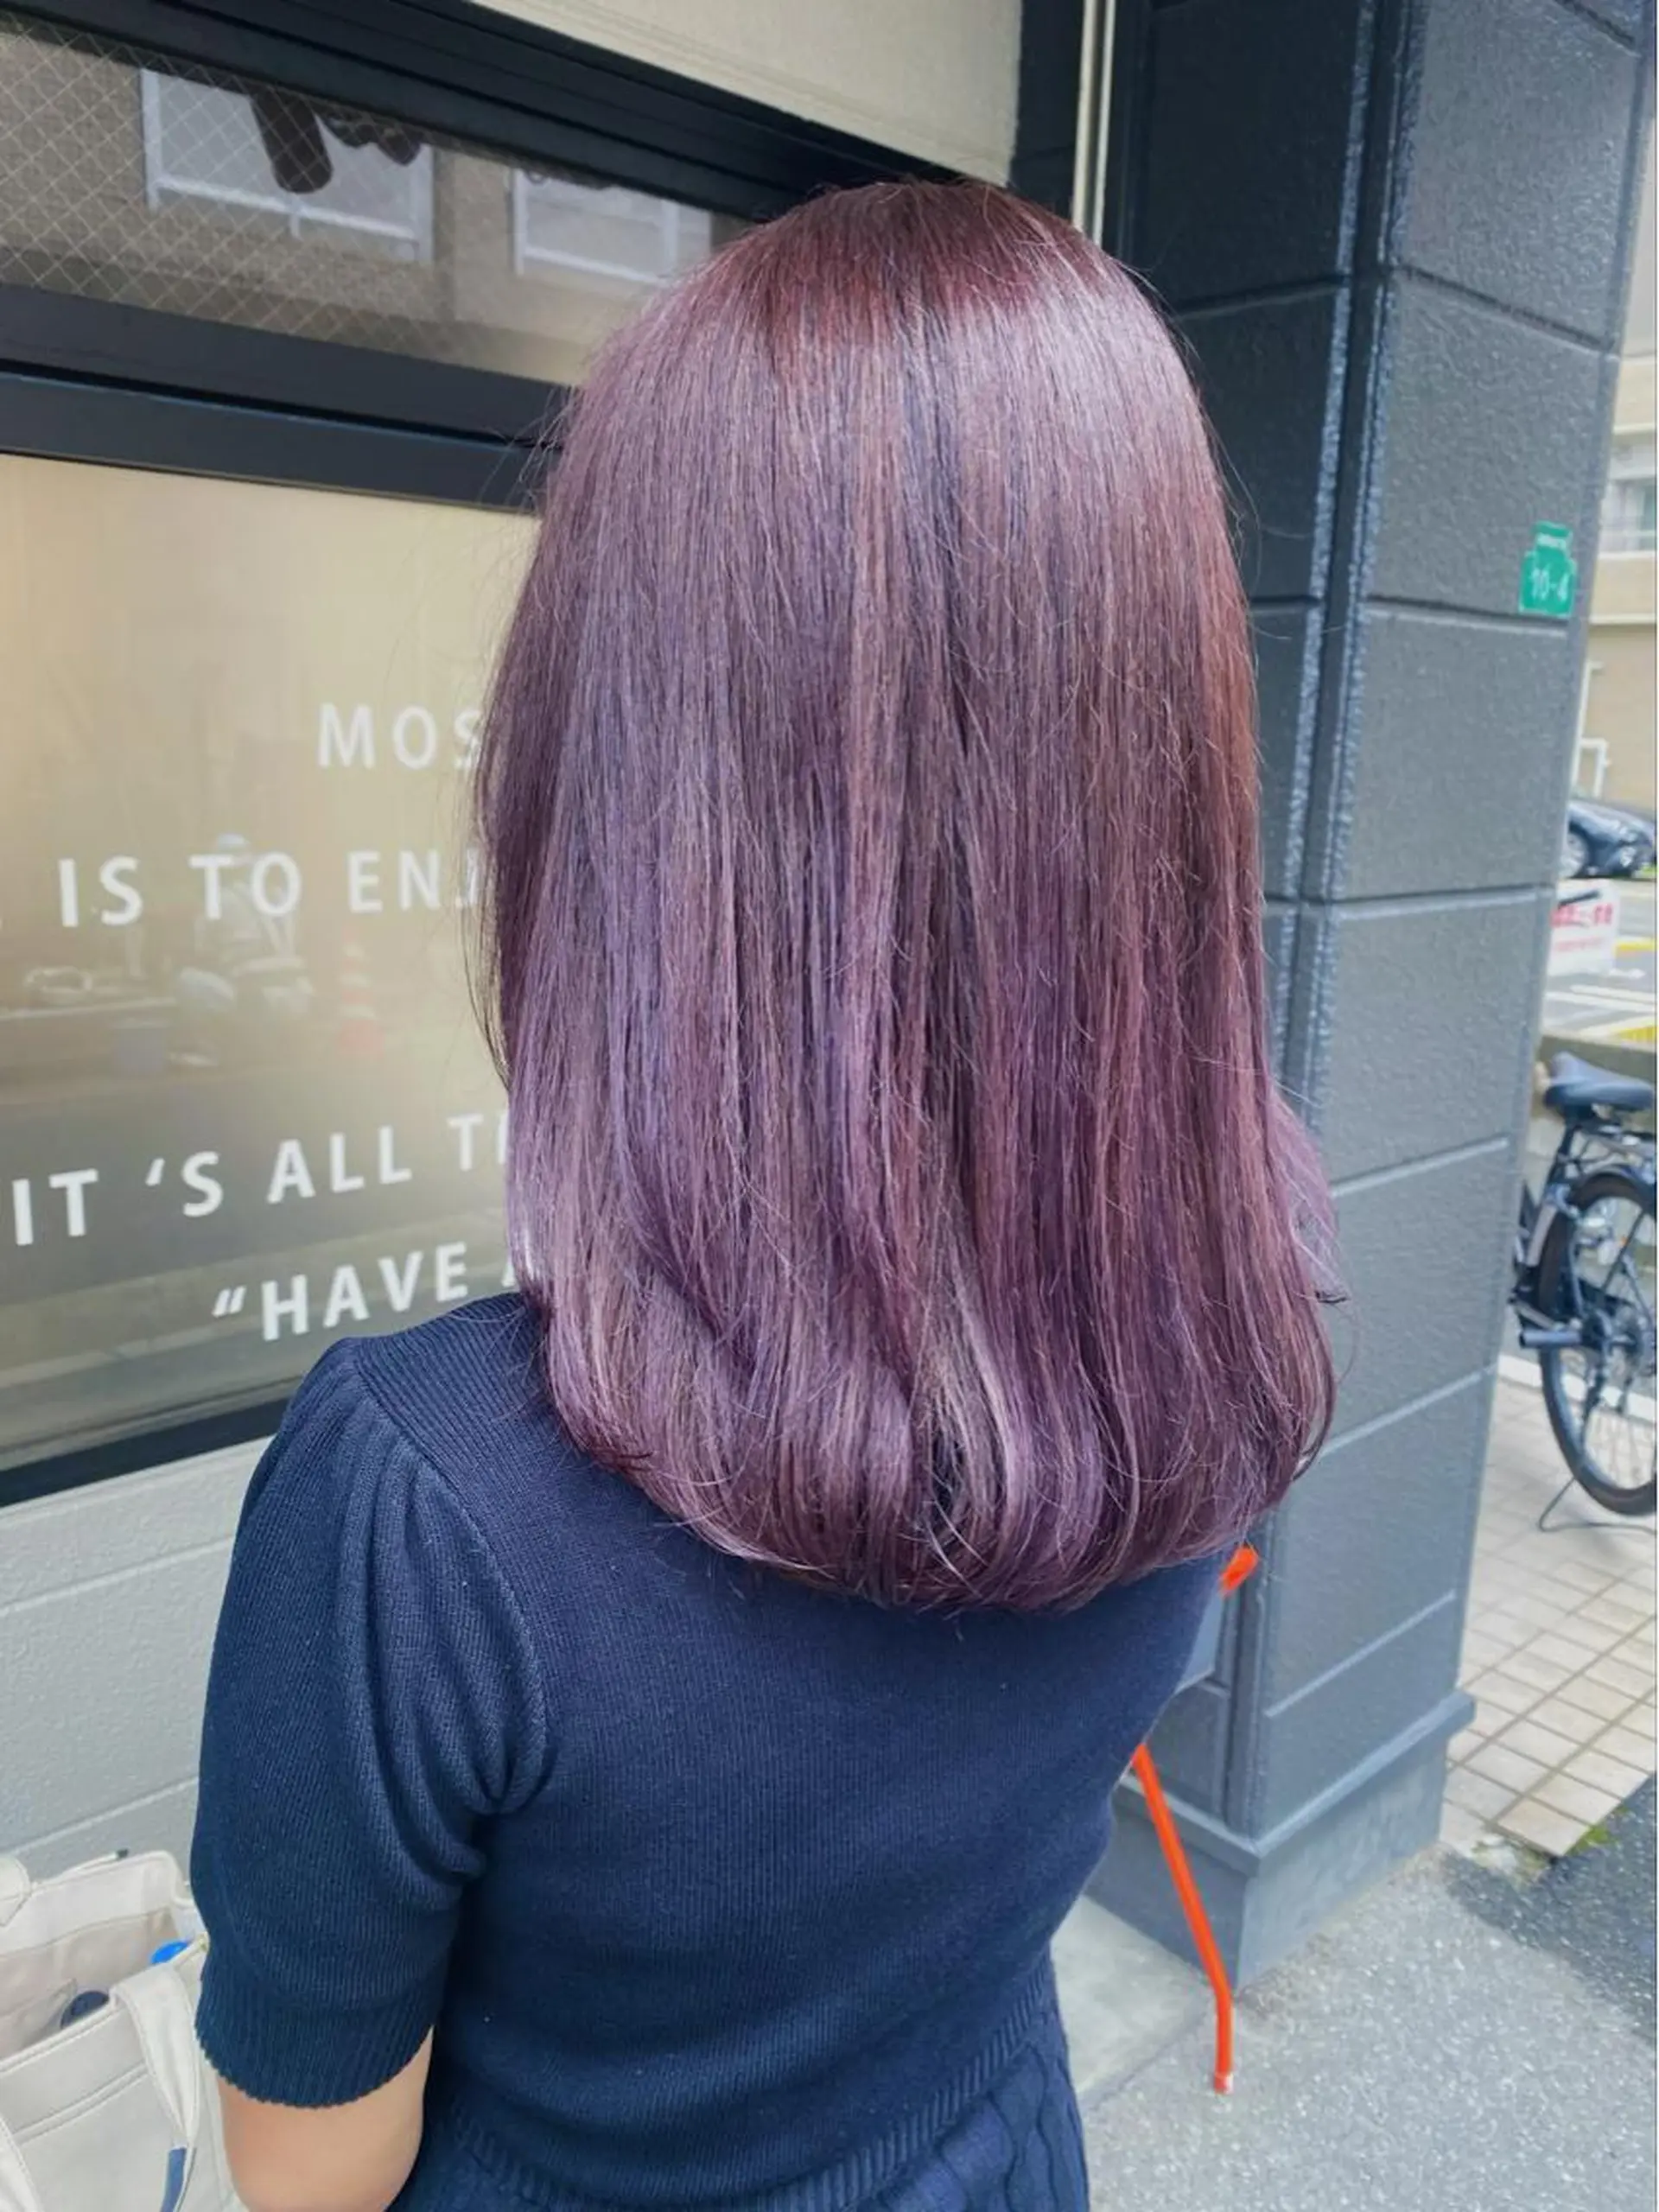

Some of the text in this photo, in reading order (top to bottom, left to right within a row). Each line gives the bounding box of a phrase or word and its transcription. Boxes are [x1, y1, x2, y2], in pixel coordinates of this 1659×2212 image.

[58, 855, 143, 928] IS
[189, 852, 302, 920] TO
[12, 1169, 99, 1246] IT
[267, 1126, 411, 1205] ALL
